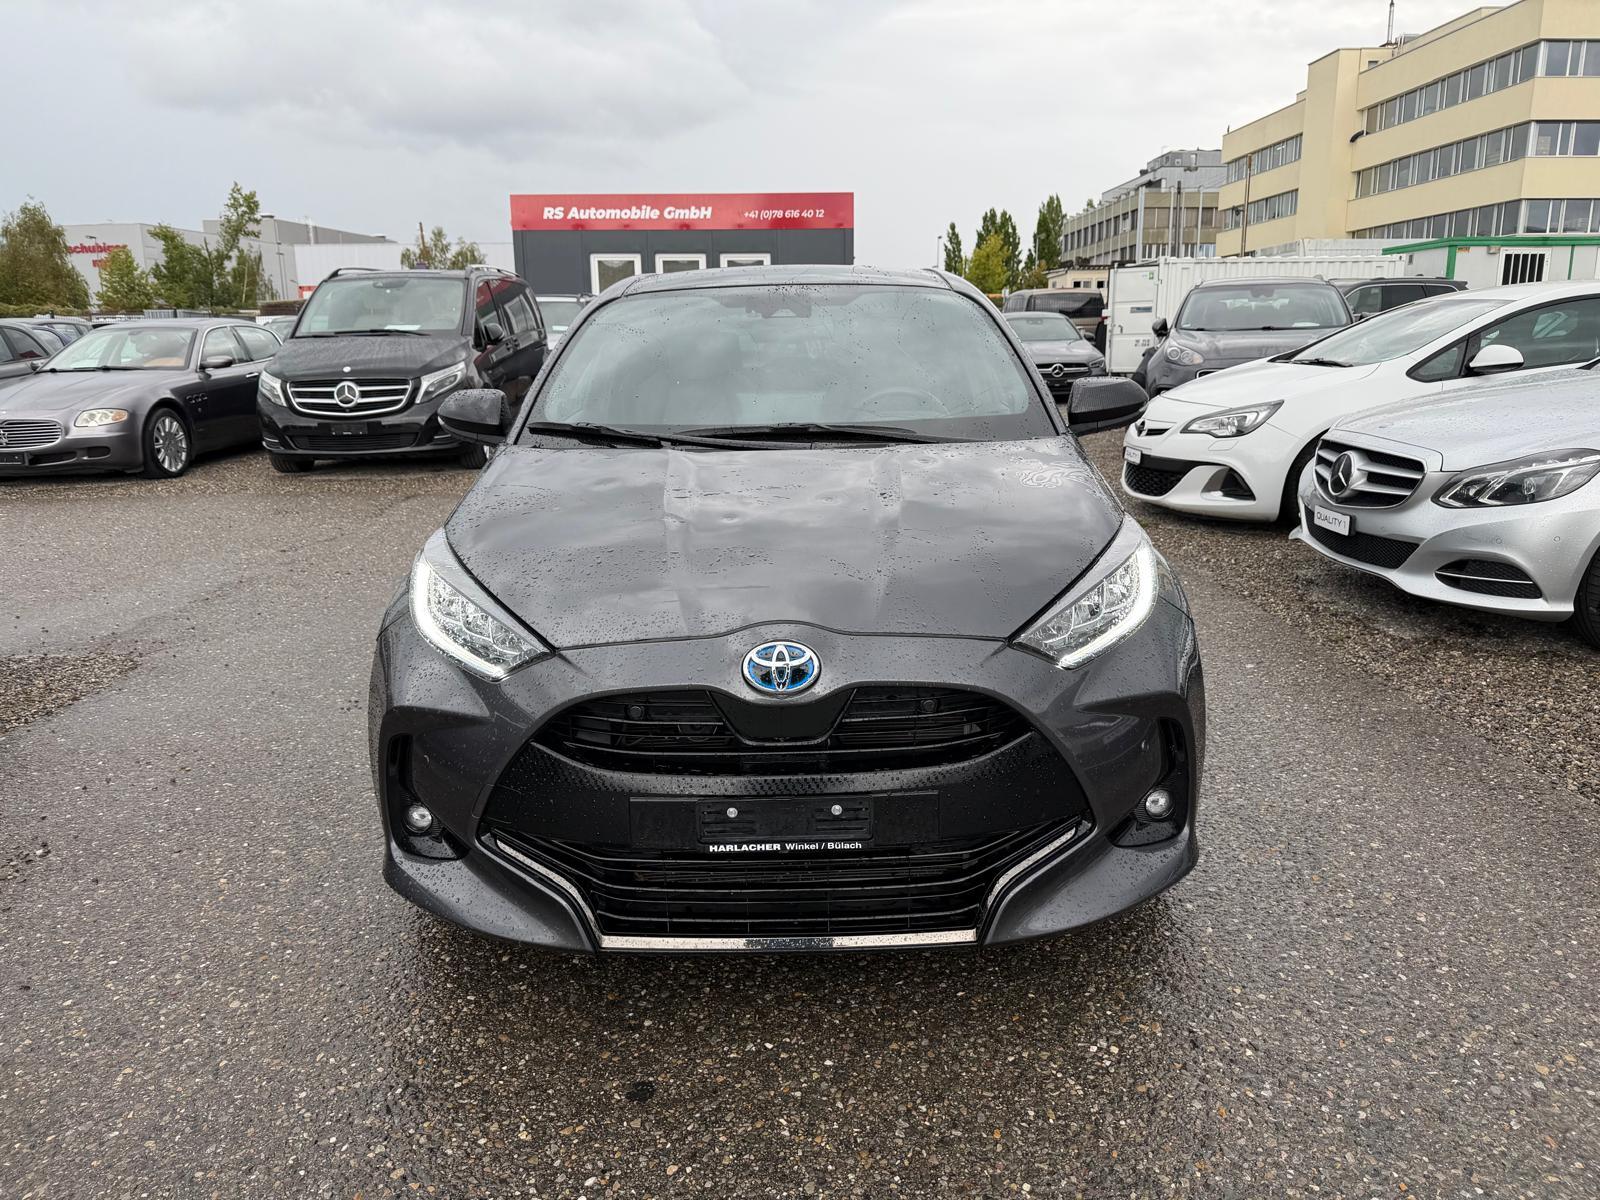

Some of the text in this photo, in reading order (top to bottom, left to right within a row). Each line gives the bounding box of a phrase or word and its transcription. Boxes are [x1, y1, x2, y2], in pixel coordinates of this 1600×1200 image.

[543, 205, 711, 219] RS Automobile GmbH
[743, 209, 825, 220] +41 (0)78 616 40 12
[1316, 511, 1343, 528] QUALITY
[709, 843, 781, 852] HARLACHER
[785, 842, 819, 850] Winkel
[827, 841, 862, 850] Bülach
